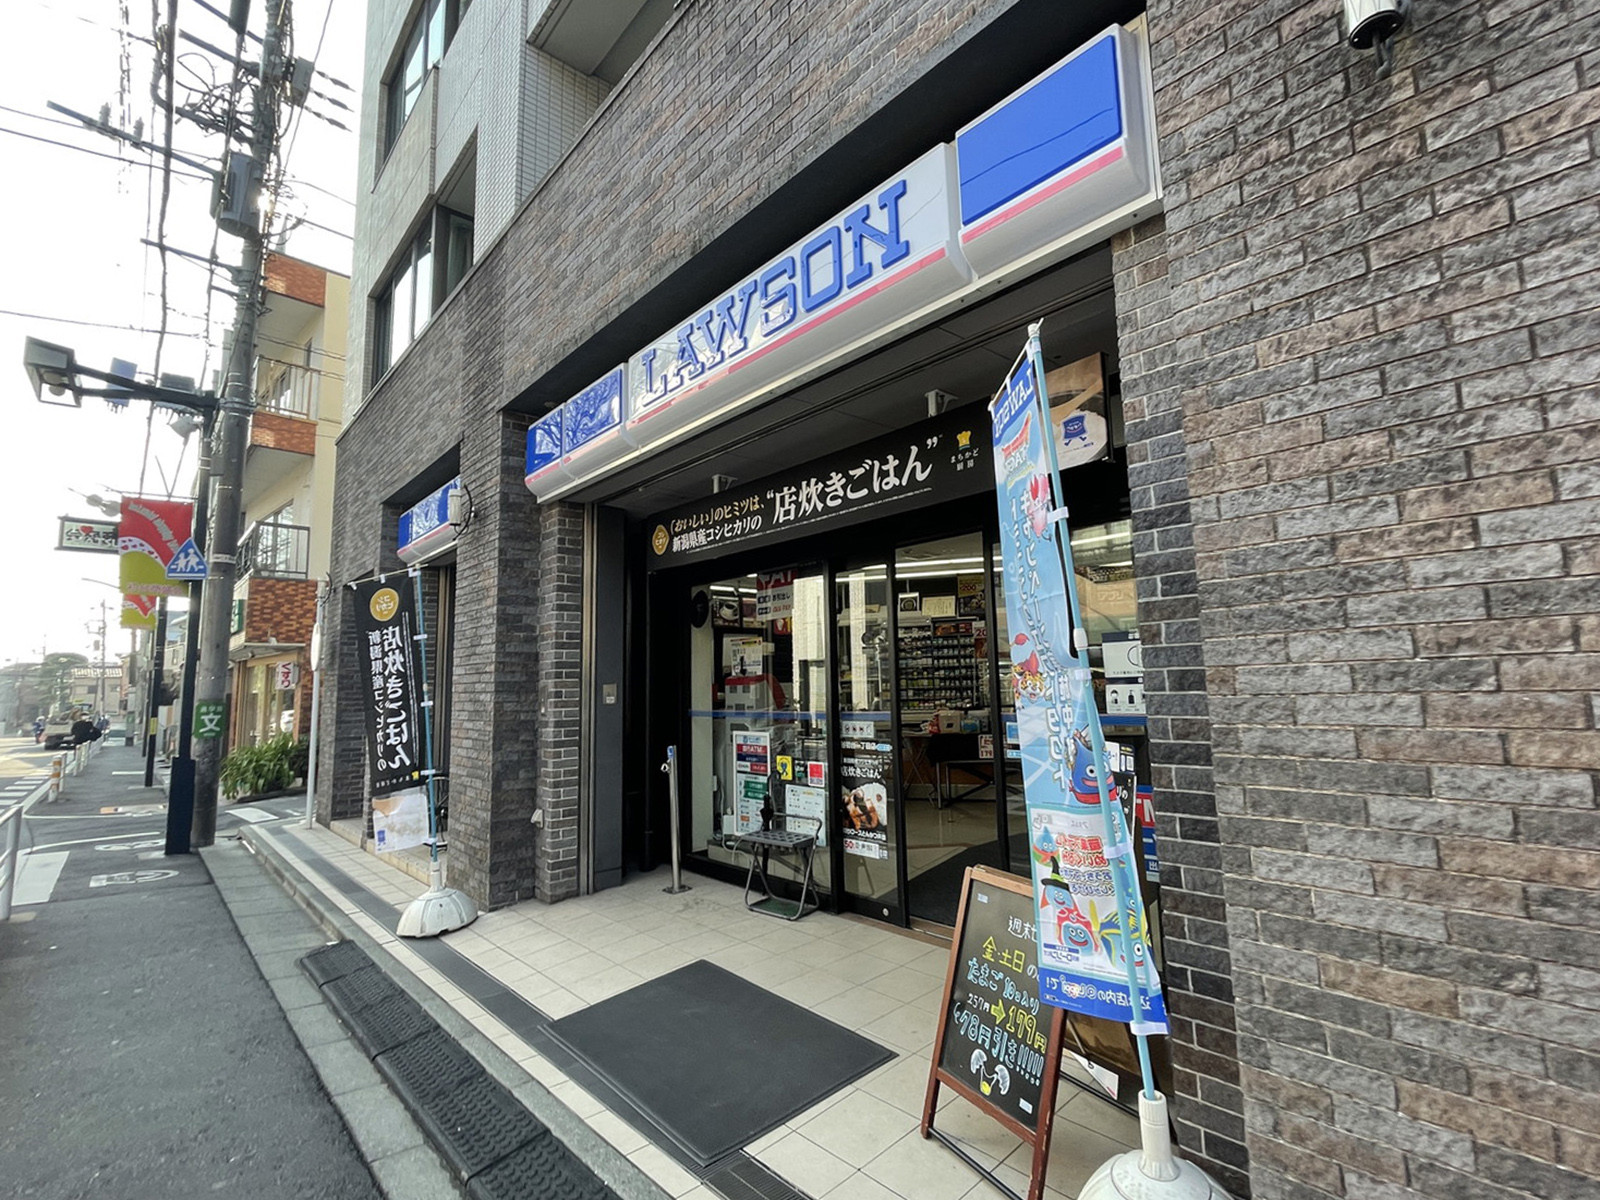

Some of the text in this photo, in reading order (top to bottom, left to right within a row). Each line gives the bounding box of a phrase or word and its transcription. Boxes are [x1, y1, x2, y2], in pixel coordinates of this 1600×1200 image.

[640, 179, 911, 407] LAWSON
[671, 514, 763, 553] 新潟県産コシヒカリの
[281, 662, 292, 688] くすり
[199, 712, 222, 733] 文
[1006, 1005, 1047, 1053] 179円
